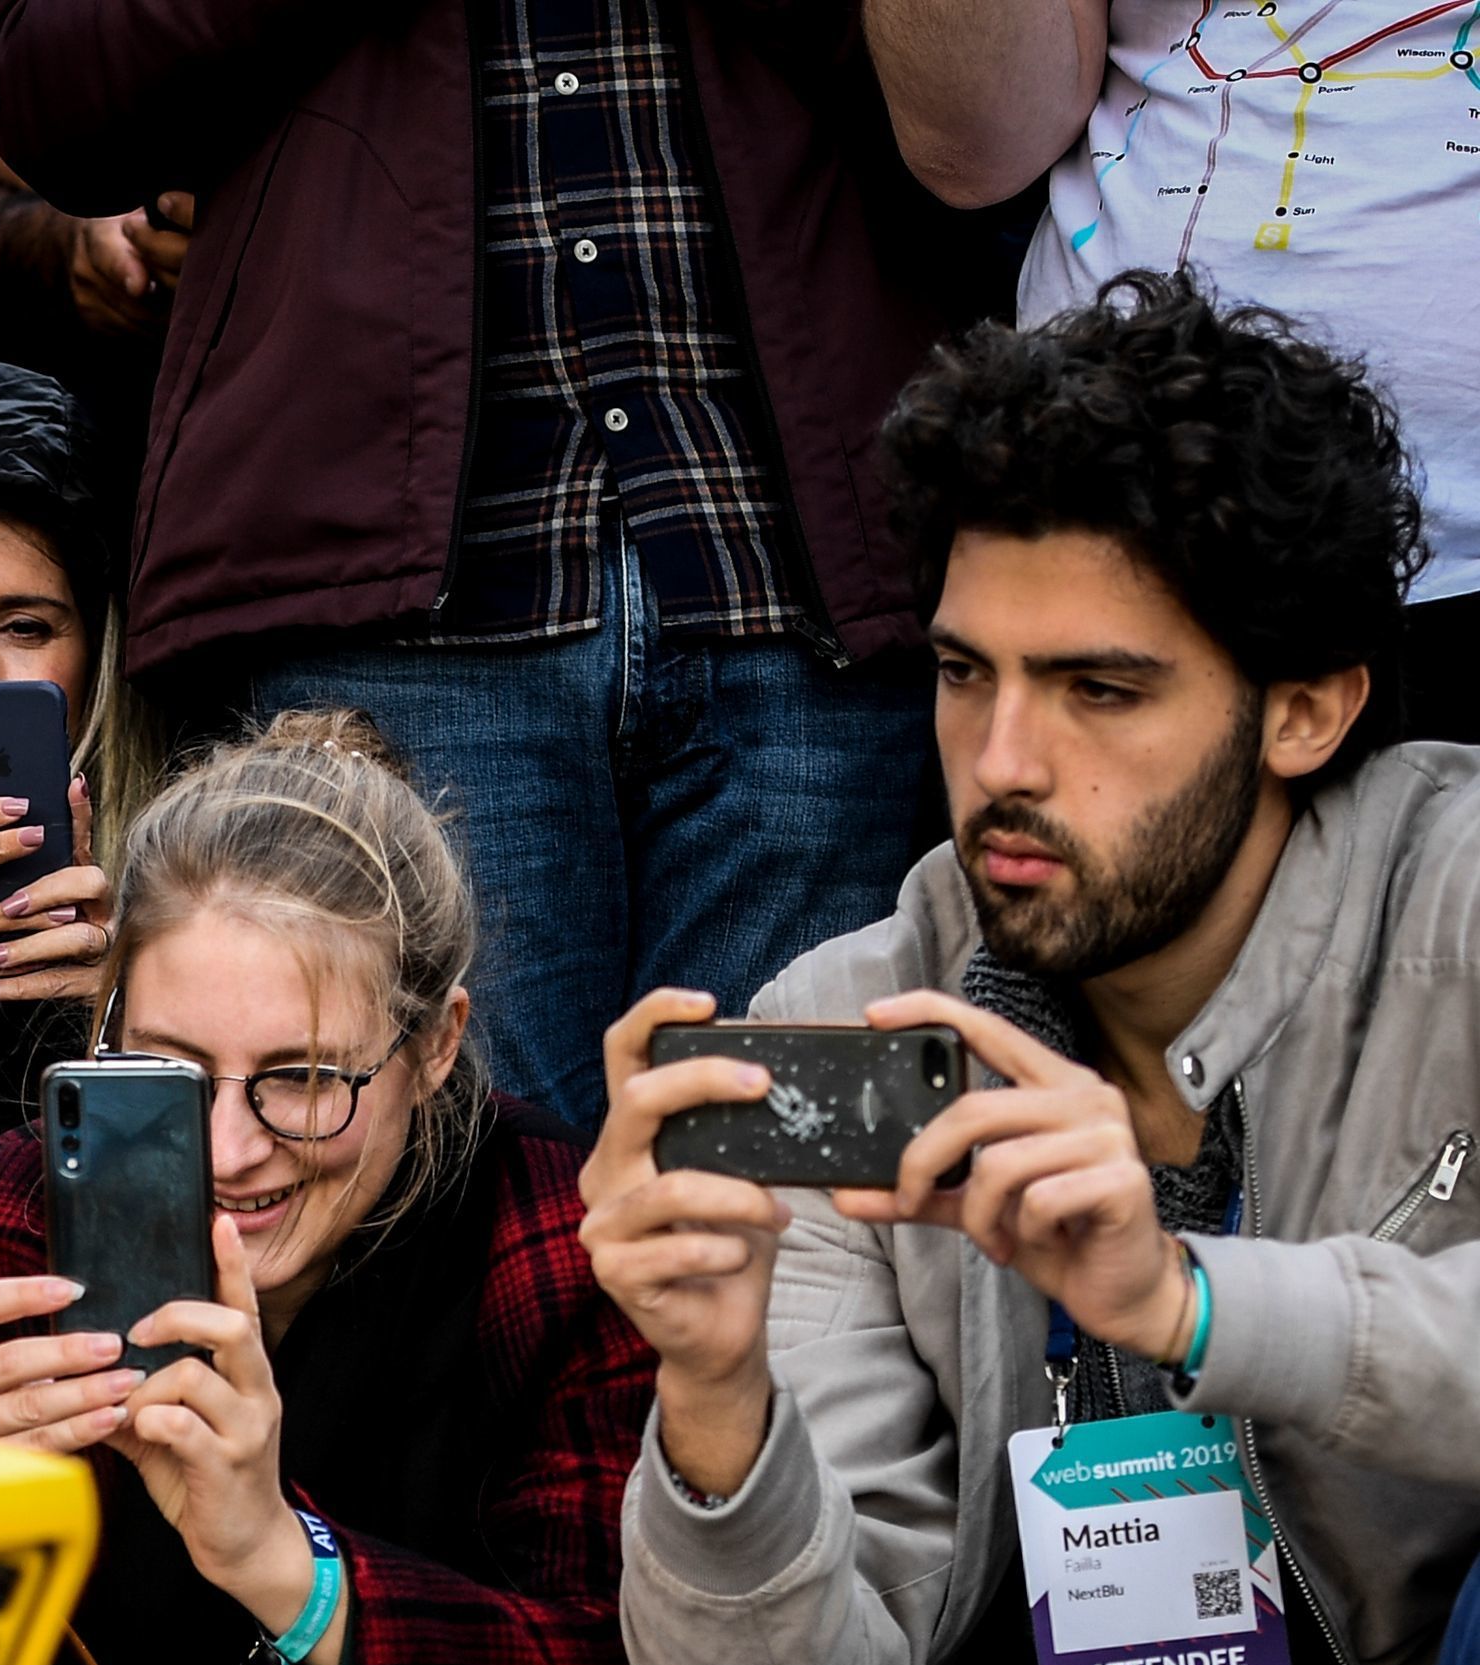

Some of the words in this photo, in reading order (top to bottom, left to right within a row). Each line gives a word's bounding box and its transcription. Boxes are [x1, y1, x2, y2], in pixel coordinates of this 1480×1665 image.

[1397, 48, 1446, 57] Wisdom
[1318, 85, 1355, 94] Power
[1304, 154, 1335, 165] Light
[1157, 185, 1192, 196] Friends
[1292, 206, 1316, 216] Sun
[1180, 1441, 1237, 1469] 2019
[1062, 1517, 1160, 1552] Mattia
[1068, 1584, 1125, 1601] NextBlu
